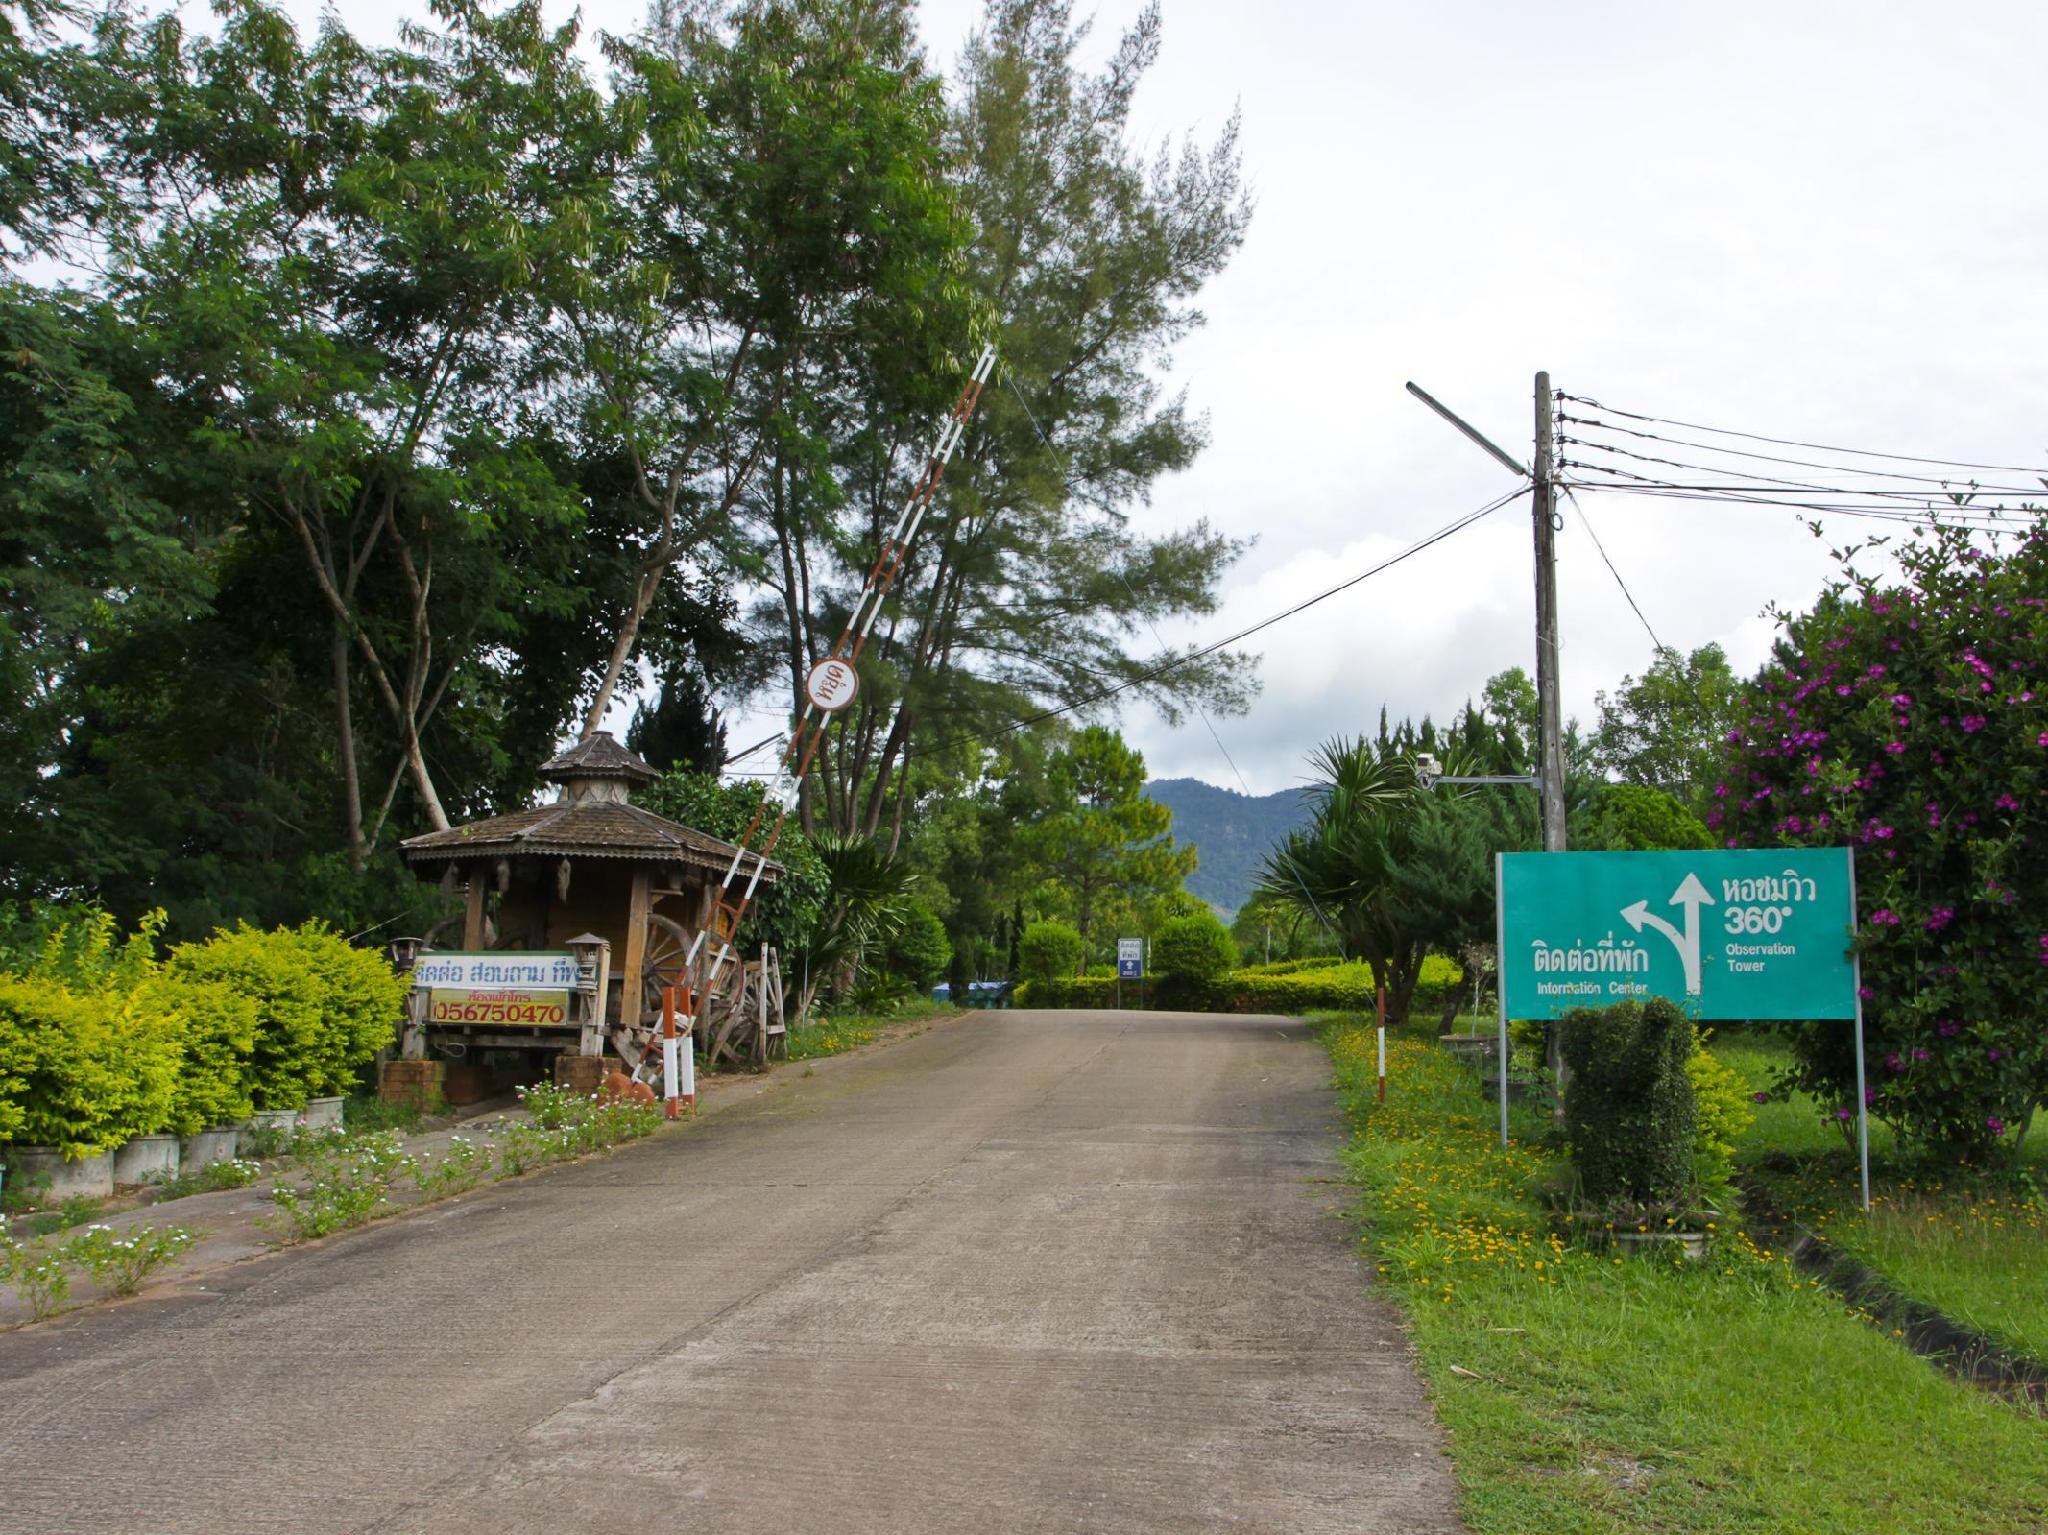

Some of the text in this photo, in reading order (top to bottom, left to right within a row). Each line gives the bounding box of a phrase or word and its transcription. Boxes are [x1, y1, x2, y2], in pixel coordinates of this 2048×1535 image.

[815, 665, 847, 701] หยุด
[1722, 869, 1816, 902] หอชมวิว
[1531, 930, 1649, 972] ติดต่อที่พัก
[1726, 943, 1796, 955] Observation
[470, 962, 544, 984] สอบถาม
[1727, 960, 1766, 972] Tower
[1608, 981, 1648, 995] Center
[433, 1002, 565, 1023] 056750470
